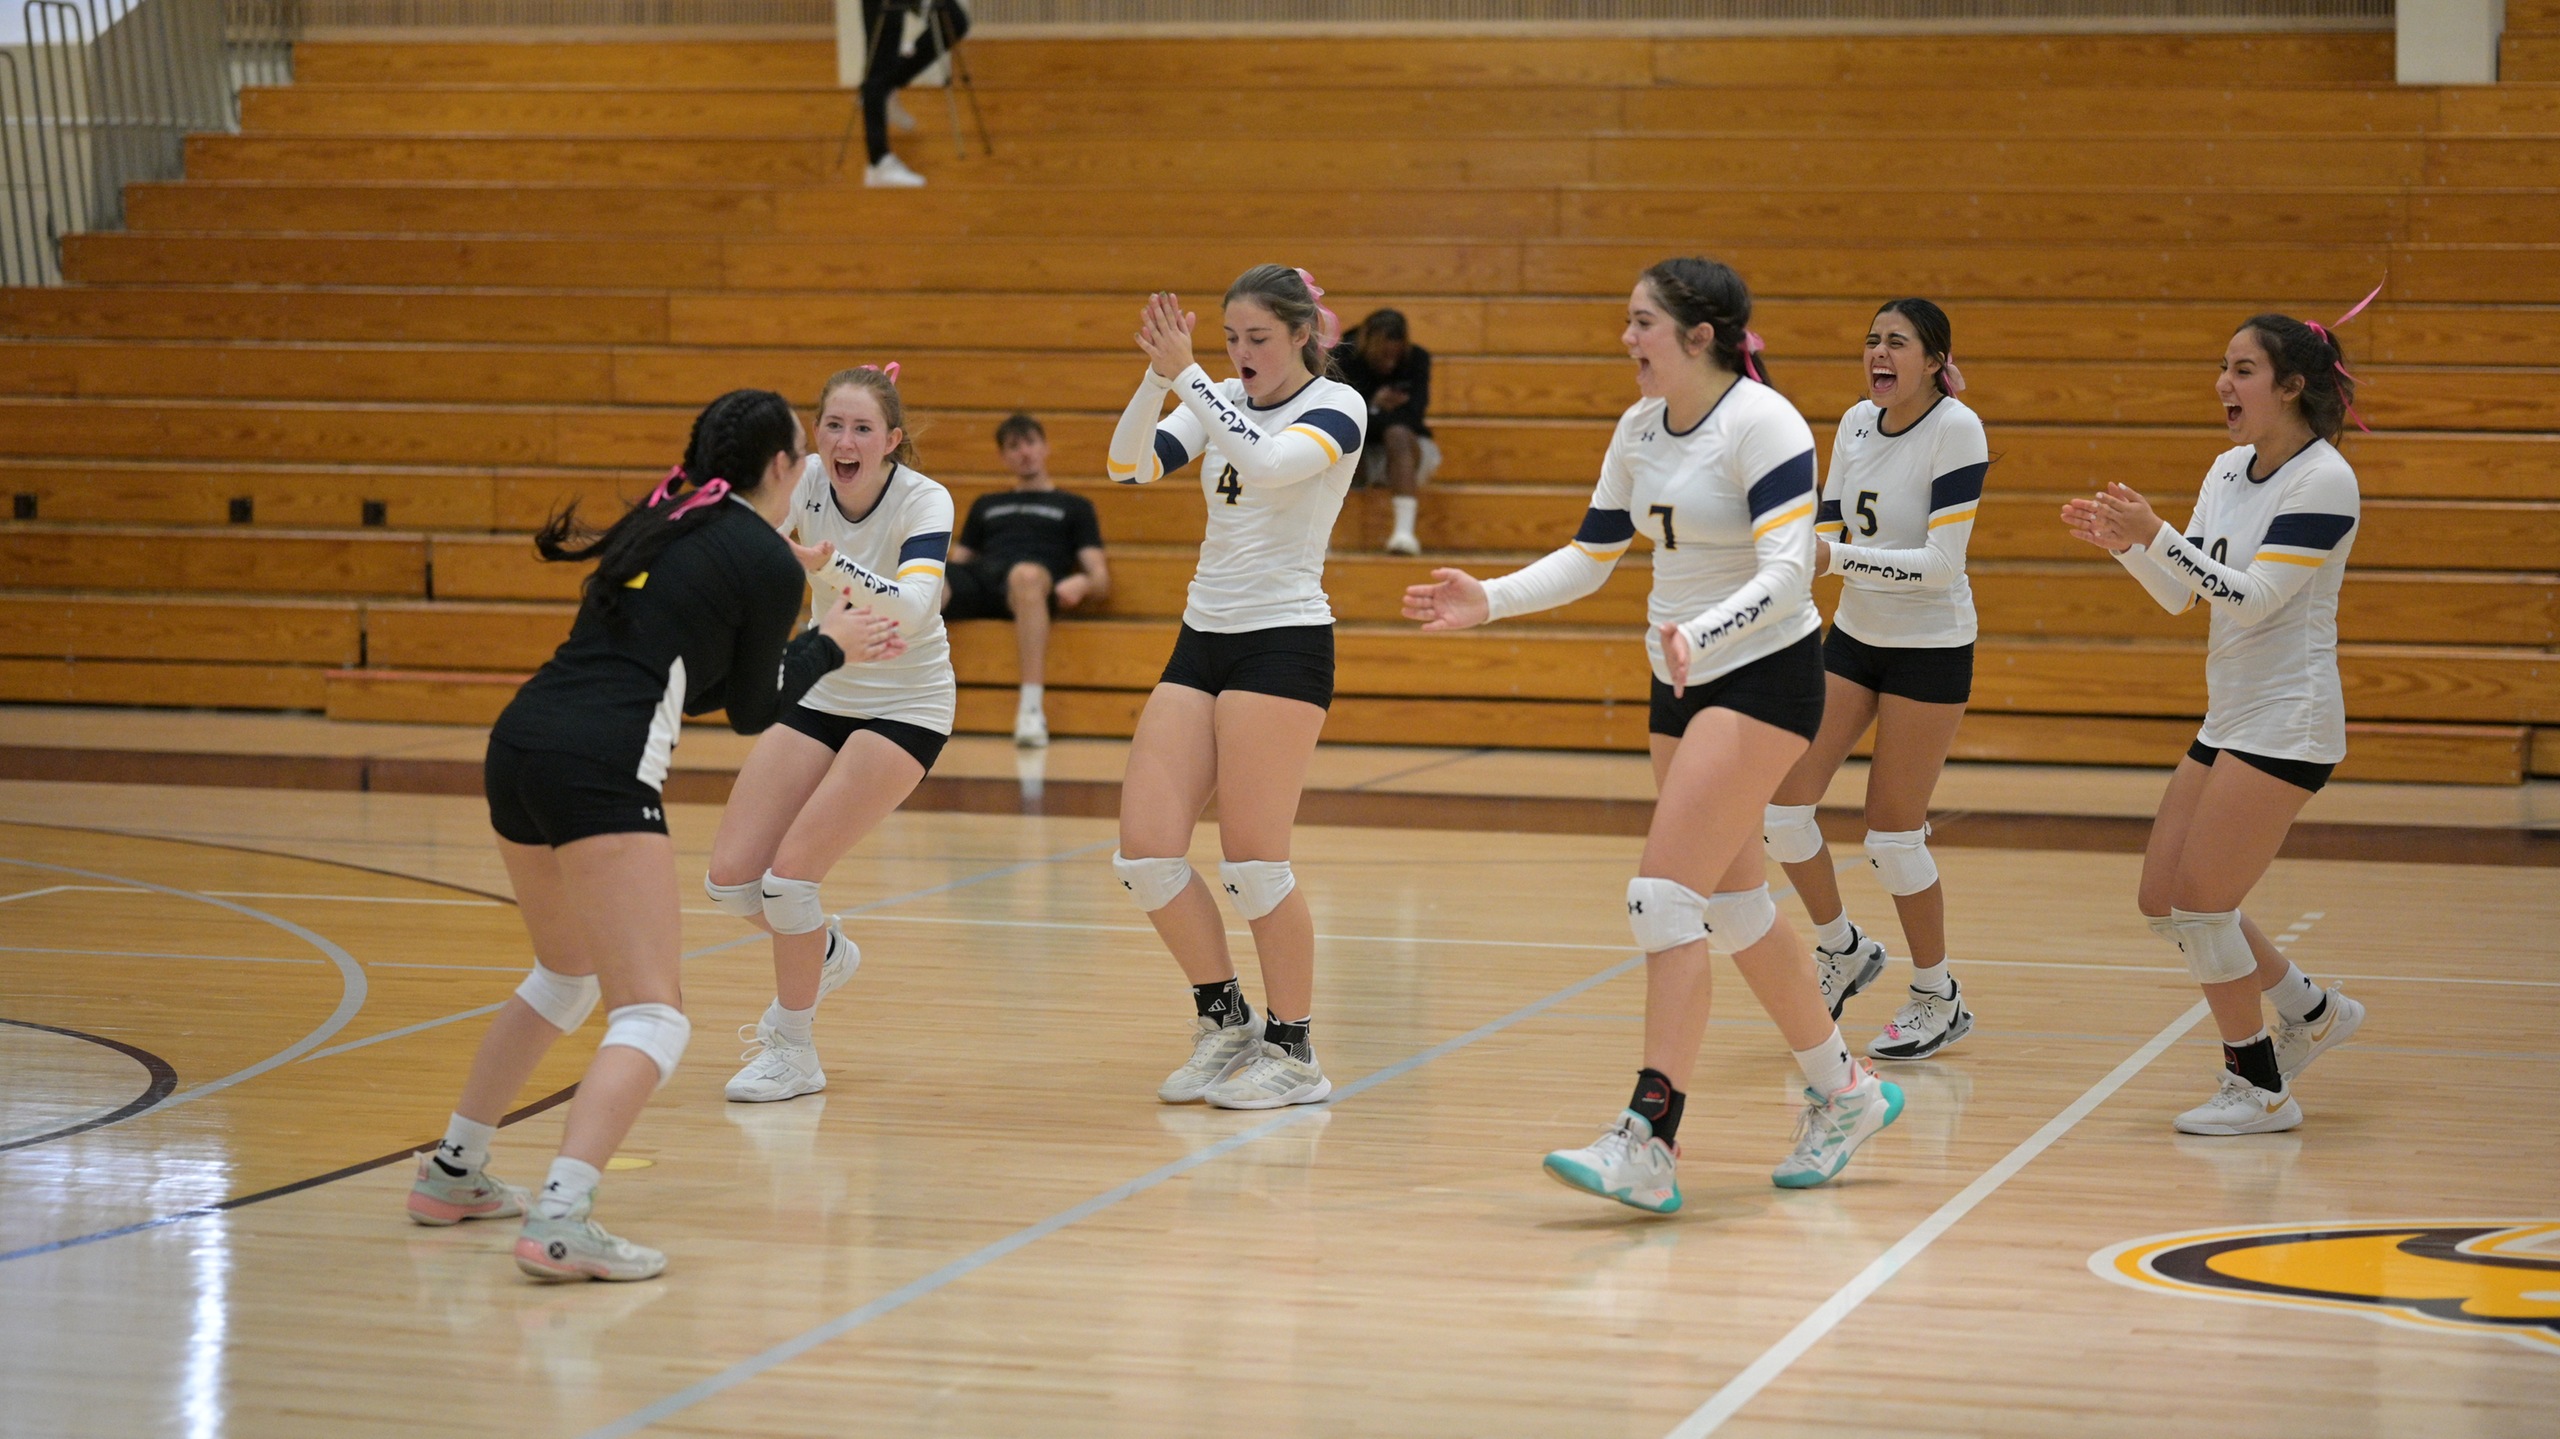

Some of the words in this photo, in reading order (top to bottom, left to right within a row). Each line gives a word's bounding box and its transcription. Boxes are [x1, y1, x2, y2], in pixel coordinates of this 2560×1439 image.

[1191, 378, 1261, 446] EAGLES
[1215, 462, 1243, 506] 4
[1648, 504, 1677, 551] 7
[1855, 490, 1880, 538] 5
[1842, 558, 1923, 582] EAGLES
[2166, 543, 2246, 606] EAGLES
[1698, 595, 1773, 649] EAGLES
